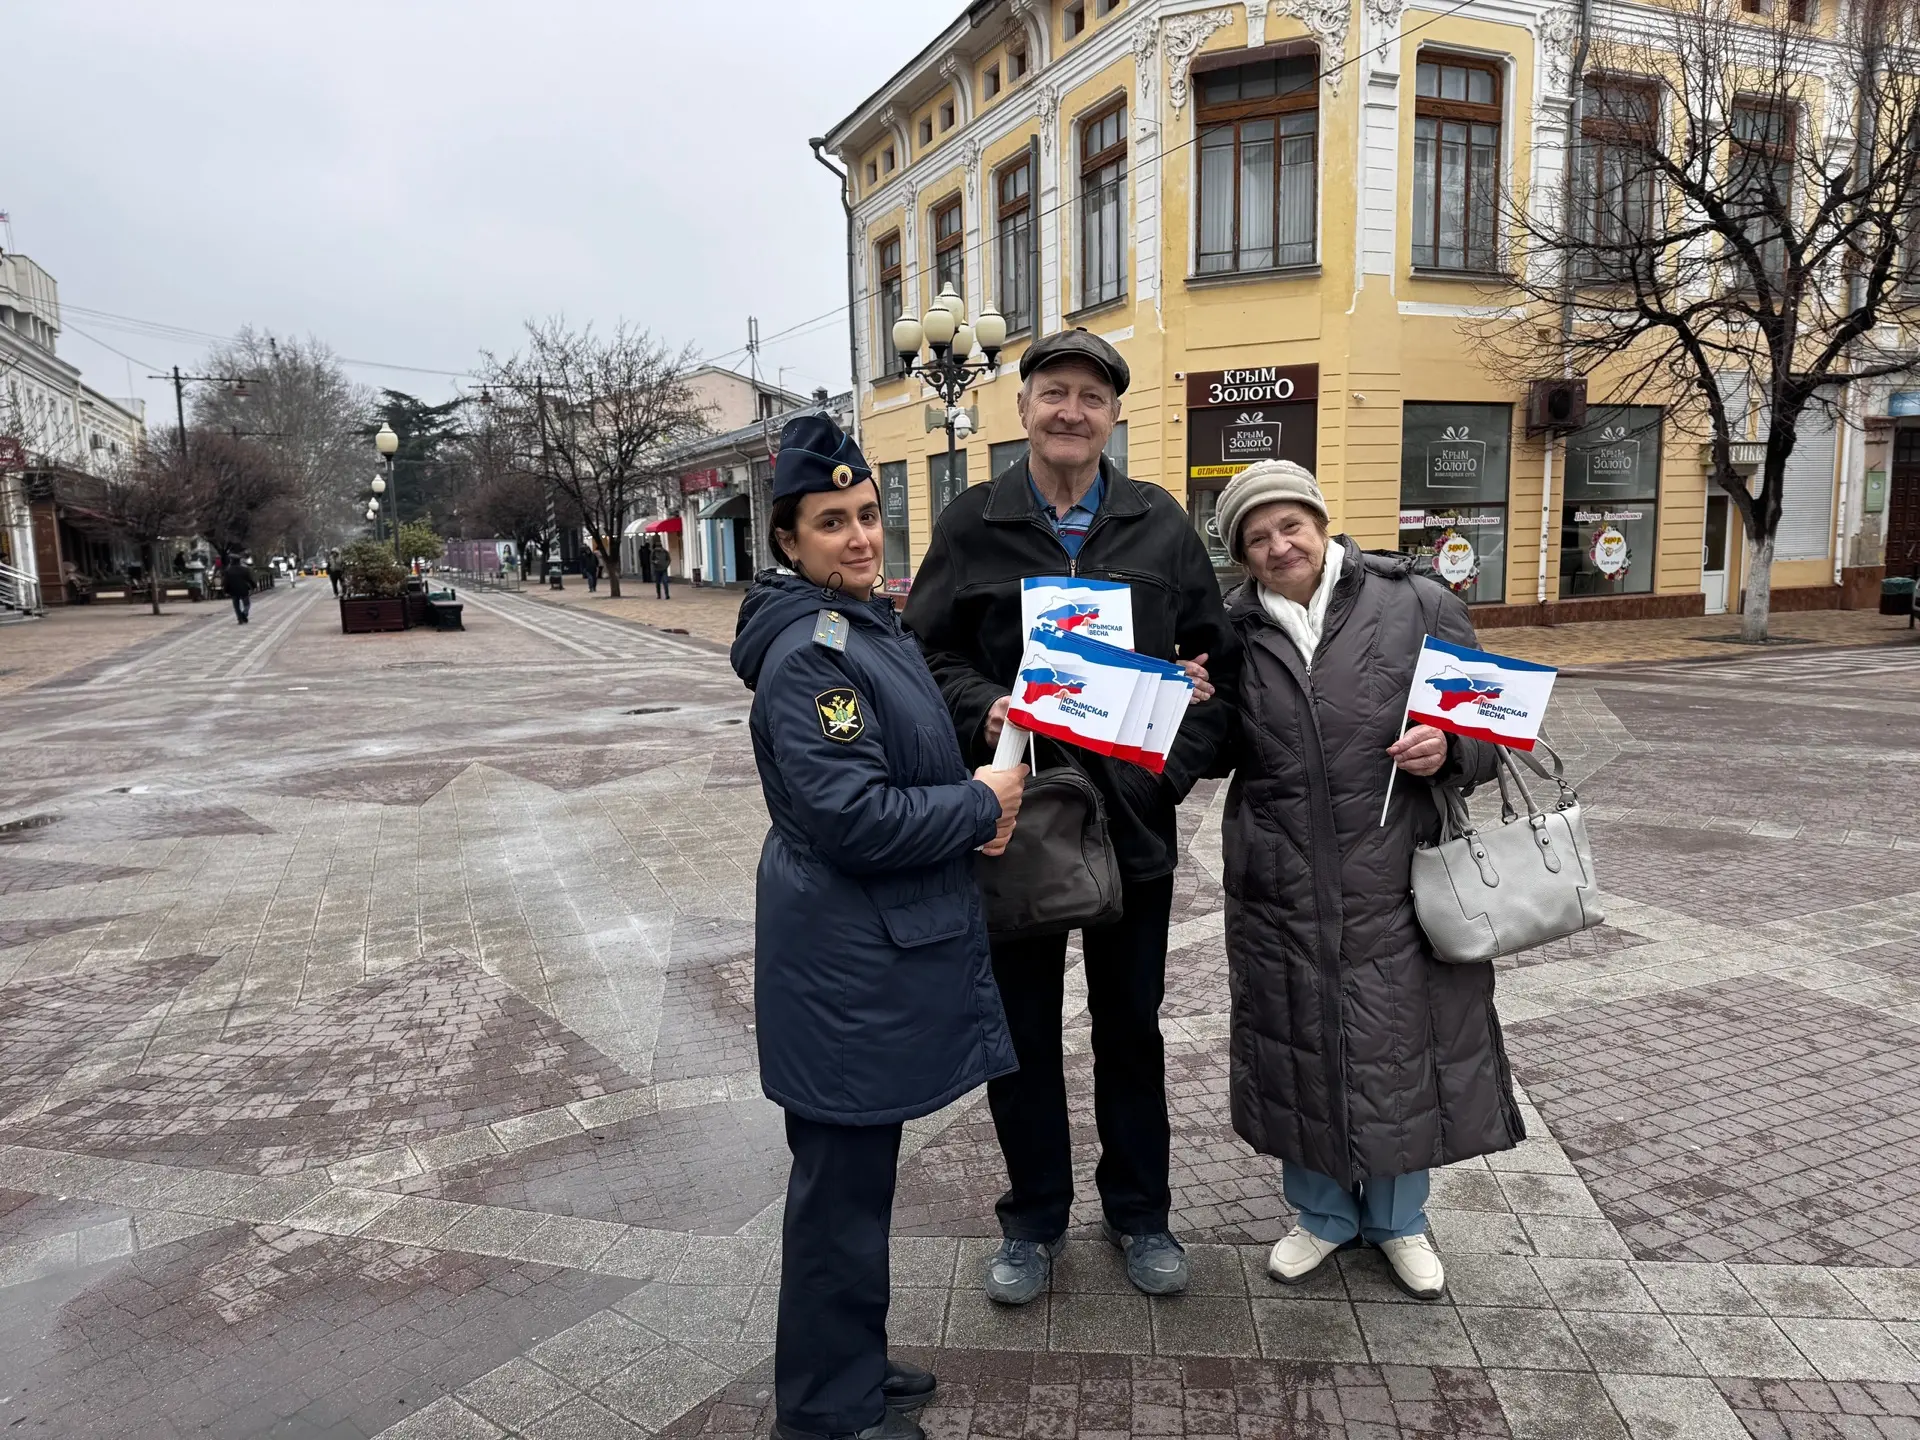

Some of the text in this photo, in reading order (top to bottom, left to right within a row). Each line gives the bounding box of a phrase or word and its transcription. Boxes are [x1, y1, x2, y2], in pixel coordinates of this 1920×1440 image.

[1223, 367, 1276, 384] КРЫМ
[1236, 430, 1264, 439] КРЫМ
[1442, 449, 1469, 460] КРЫМ
[1197, 466, 1234, 476] ОТЛИЧНАЯ
[1088, 623, 1122, 632] КРЫМСКАЯ
[1060, 704, 1086, 719] ВЕСНА
[1062, 697, 1109, 718] КРЫМСКАЯ
[1481, 702, 1528, 718] КРЫМСКАЯ
[1479, 709, 1506, 720] ВЕСНА
